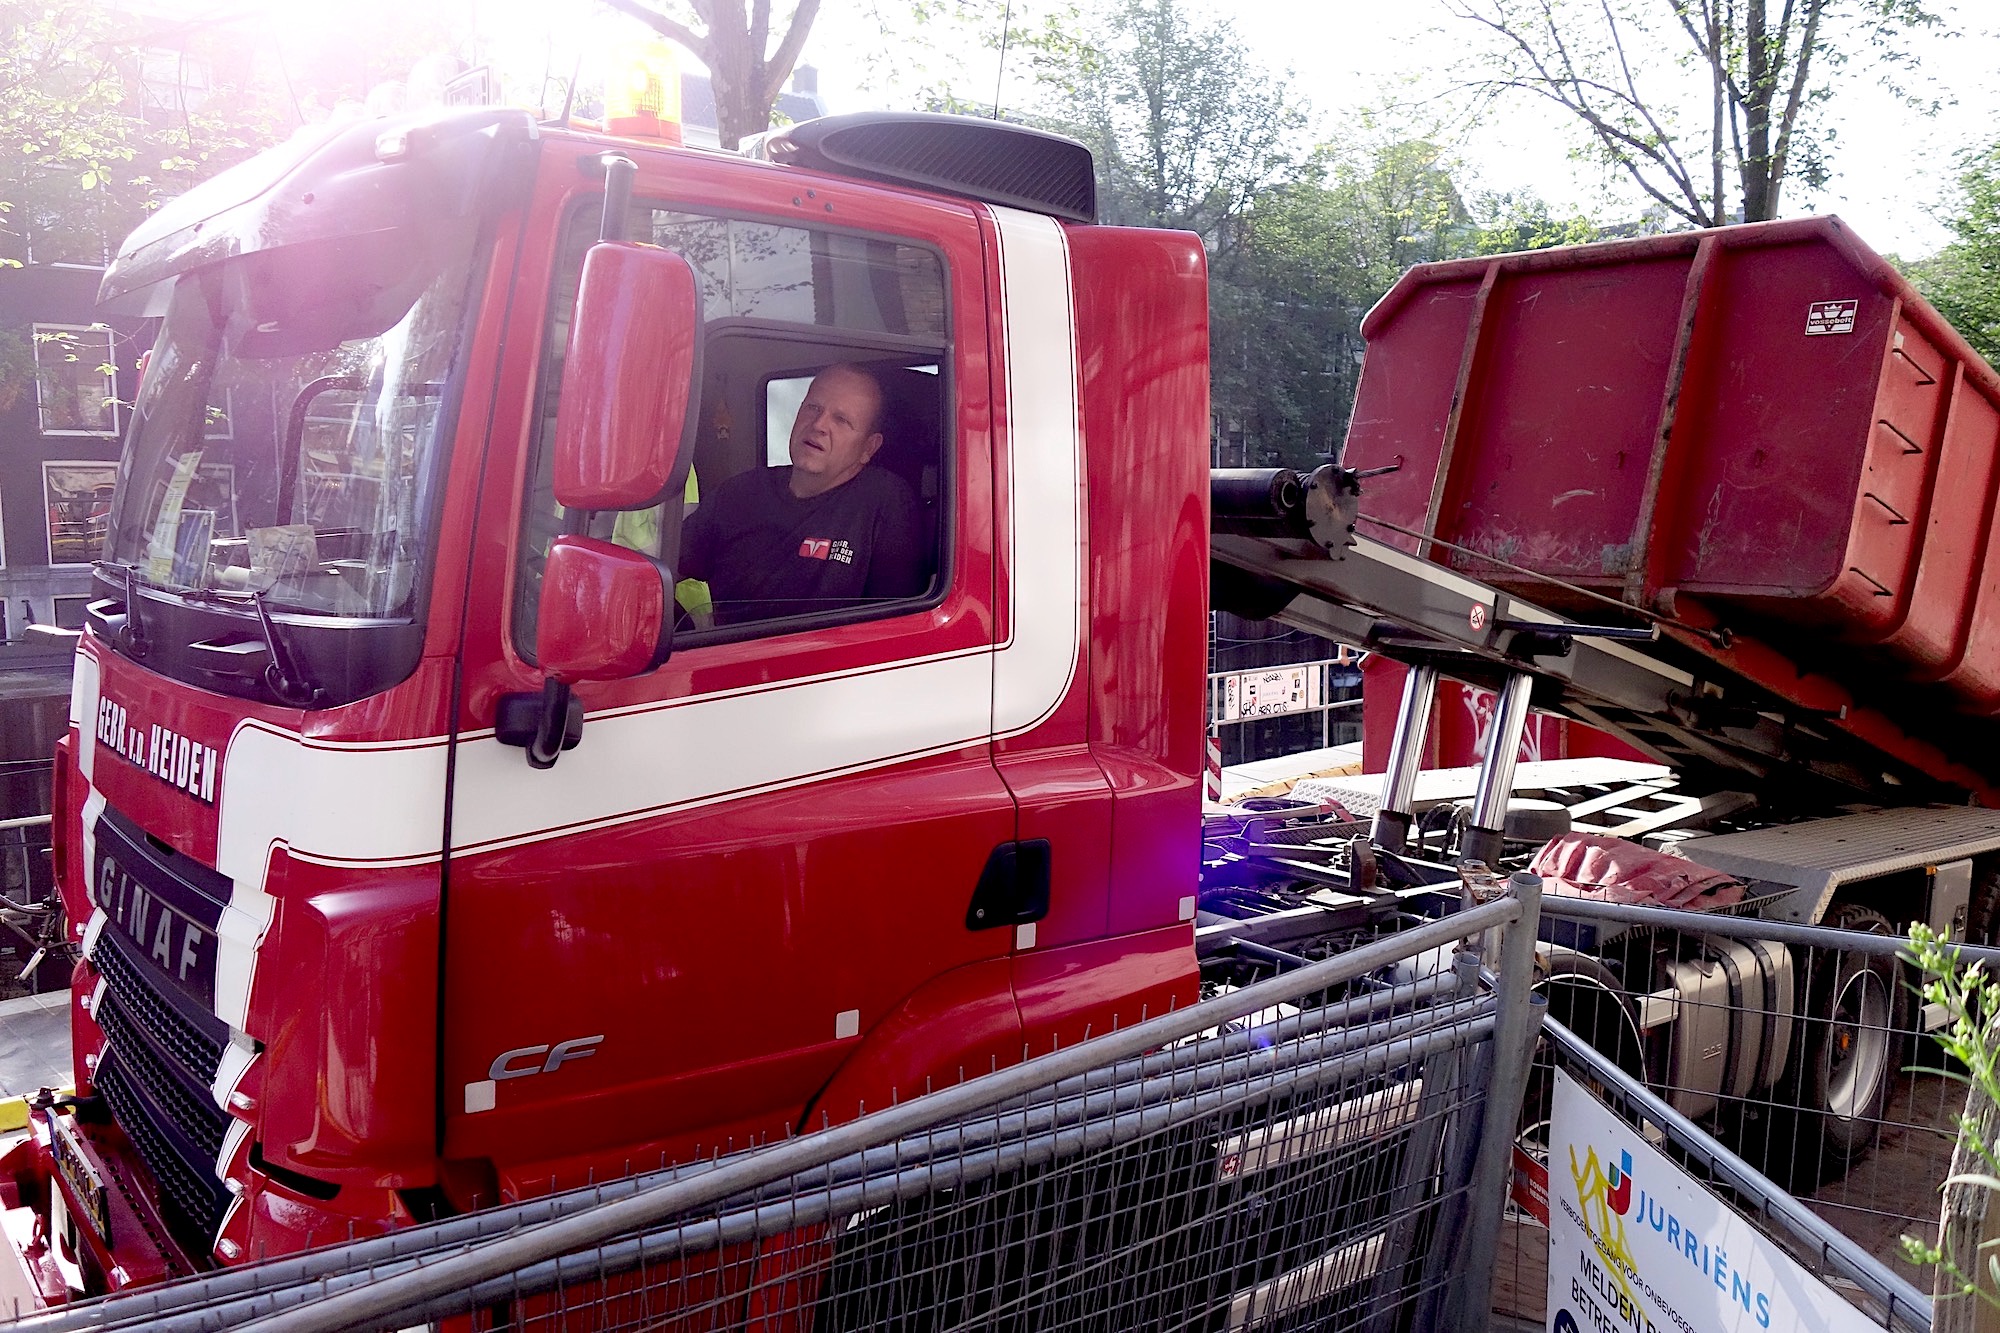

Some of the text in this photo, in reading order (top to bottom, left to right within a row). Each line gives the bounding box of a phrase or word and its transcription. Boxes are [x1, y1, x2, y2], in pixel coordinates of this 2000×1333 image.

[840, 548, 853, 557] DER
[97, 695, 127, 756] GEBR.
[148, 723, 218, 803] HEIDEN
[100, 856, 202, 981] GINAF
[488, 1034, 605, 1081] CF
[1560, 1196, 1697, 1333] VERBODEN TOEGANG VOOR ONBEVOEG
[1580, 1249, 1641, 1333] MELDEN
[1636, 1190, 1770, 1329] JURRIËNS
